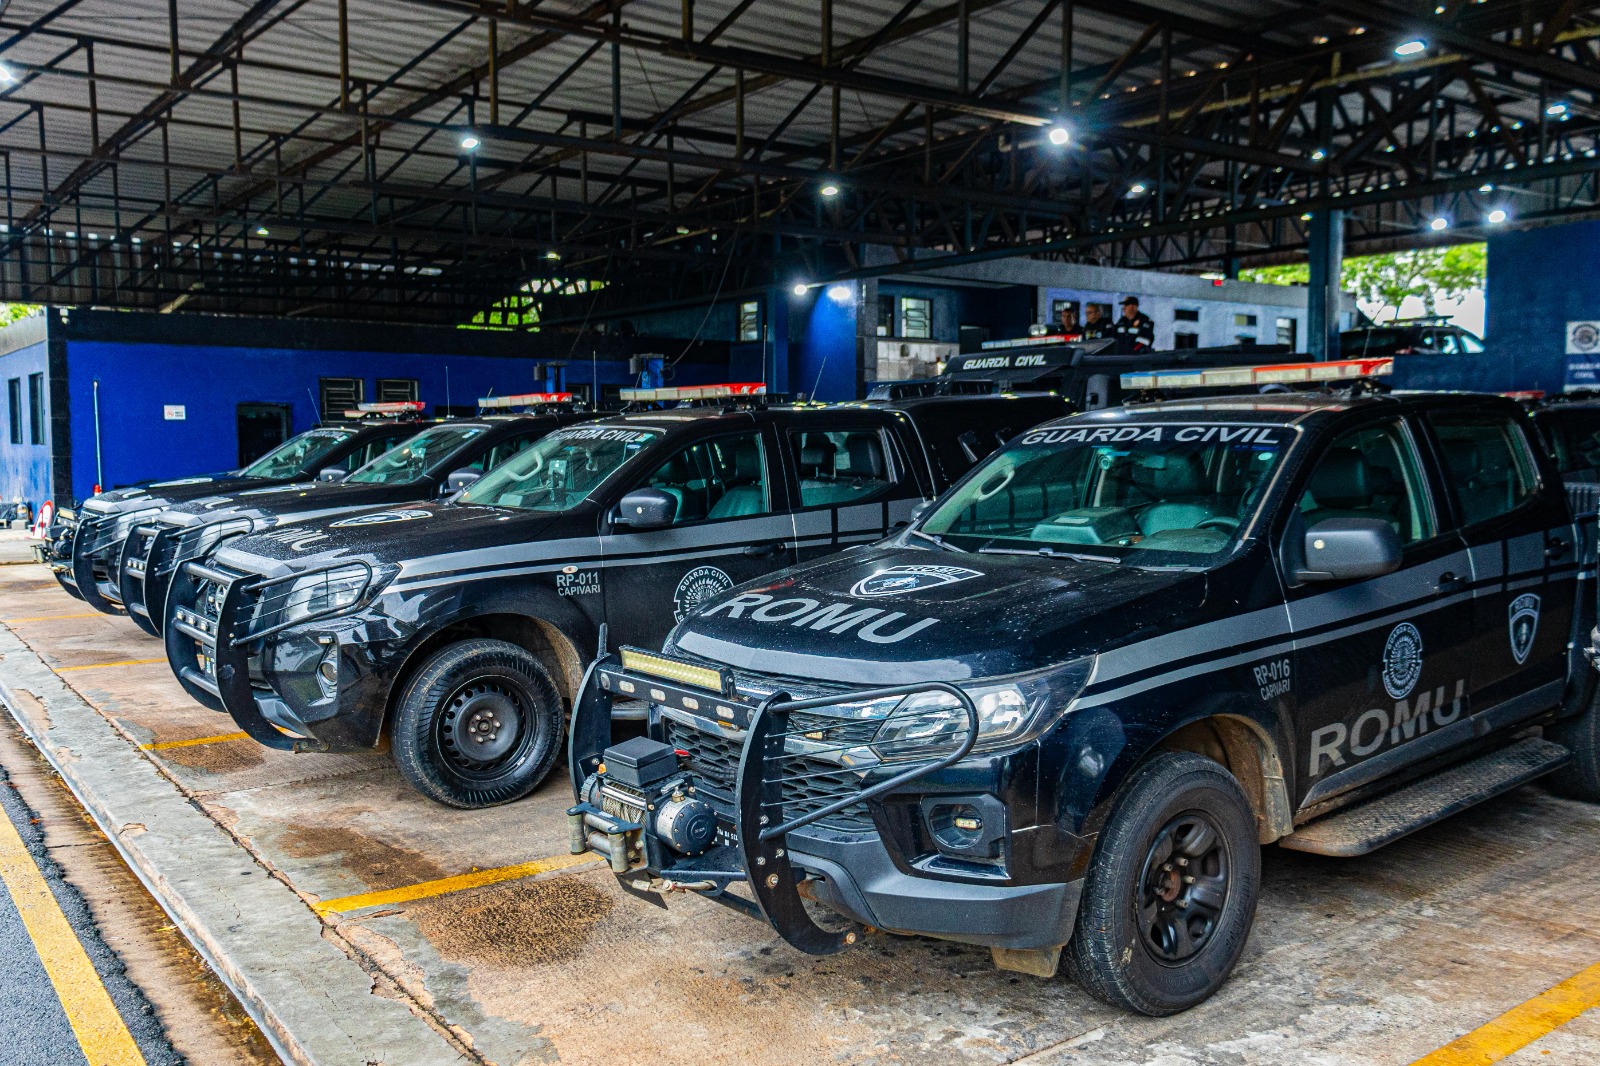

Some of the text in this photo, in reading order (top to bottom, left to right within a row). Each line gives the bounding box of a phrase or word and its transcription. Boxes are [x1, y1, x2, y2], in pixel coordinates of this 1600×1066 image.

[963, 355, 1047, 370] GUARDA CIVIL
[601, 430, 640, 442] CIVIL
[1021, 427, 1280, 445] GUARDA CIVIL
[556, 571, 598, 587] RP-011
[680, 569, 729, 591] GUARDA CIVIL
[558, 584, 601, 596] CAPIVARI
[701, 593, 940, 644] ROMU
[1253, 659, 1290, 686] RP-016
[1309, 679, 1464, 777] ROMU
